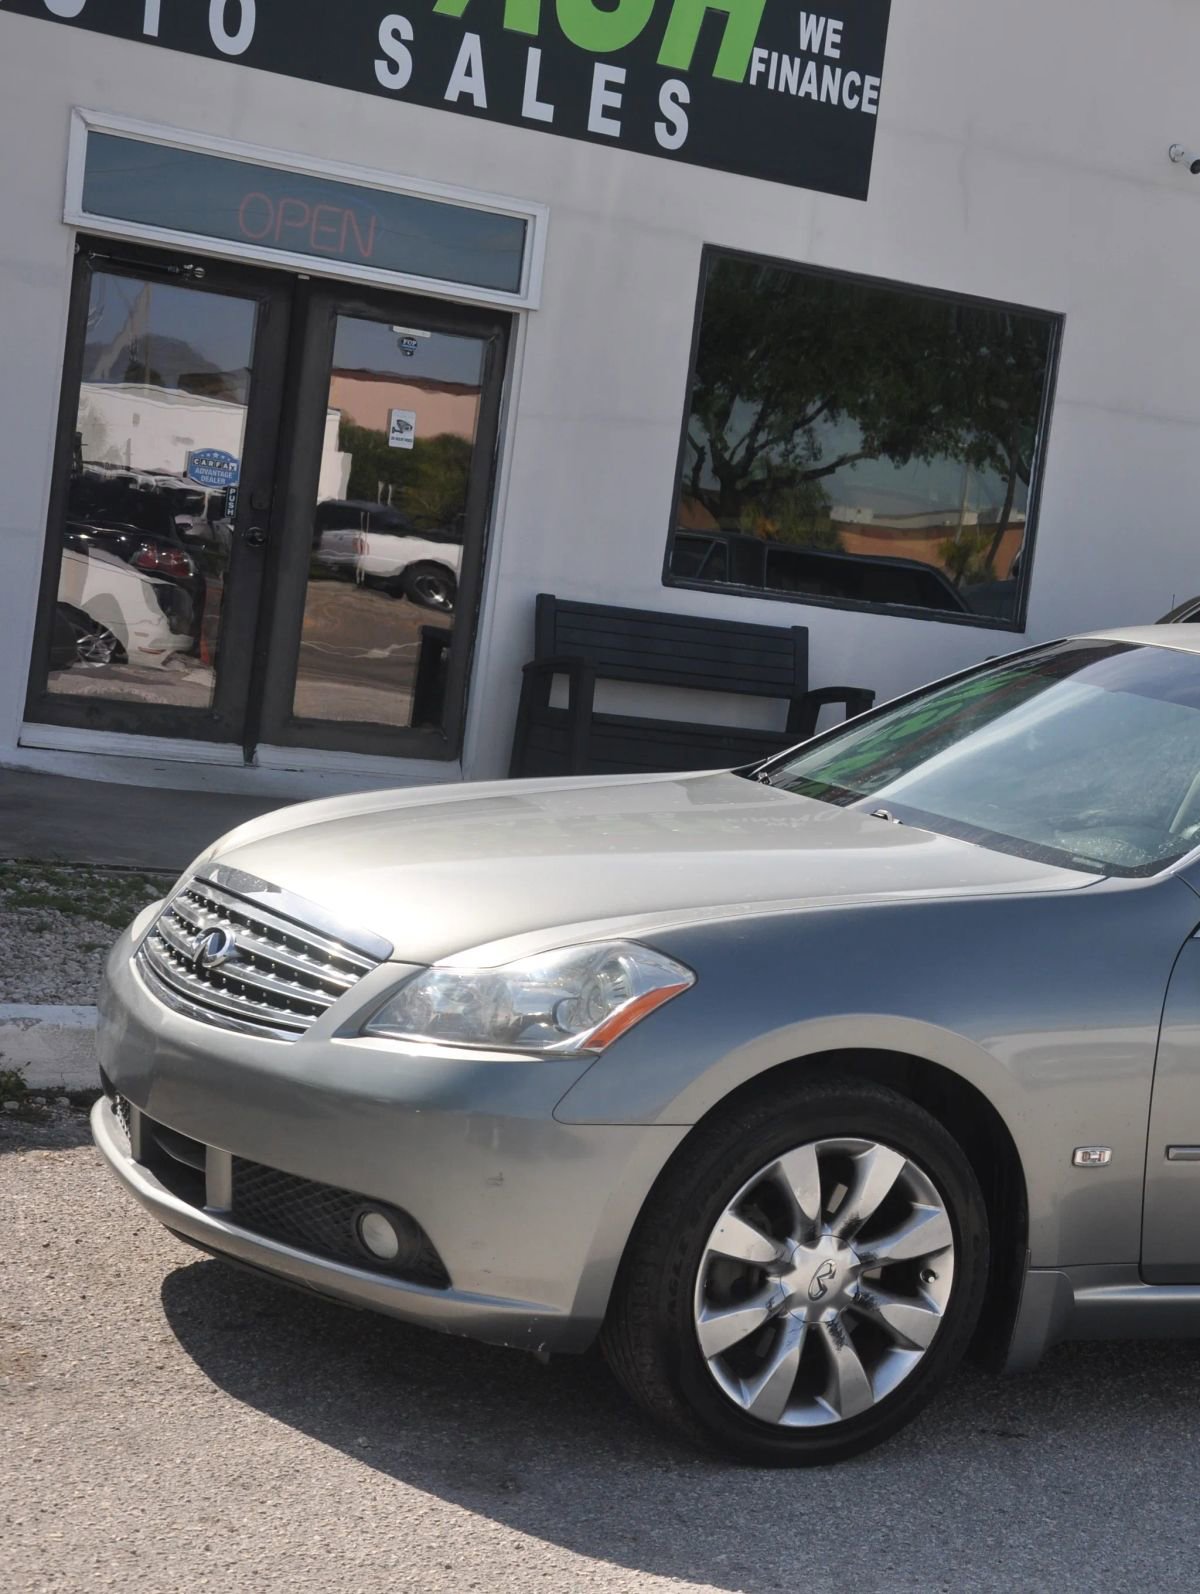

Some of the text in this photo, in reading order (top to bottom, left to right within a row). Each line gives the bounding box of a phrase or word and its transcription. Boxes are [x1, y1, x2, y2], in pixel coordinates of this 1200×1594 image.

[800, 11, 844, 59] WE
[374, 13, 691, 151] SALES
[749, 46, 881, 115] FINANCE
[238, 191, 377, 258] OPEN
[193, 458, 238, 472] CARFAX
[194, 467, 233, 479] ADVANTAGE
[200, 475, 226, 484] DEALER
[227, 488, 236, 516] PUSH
